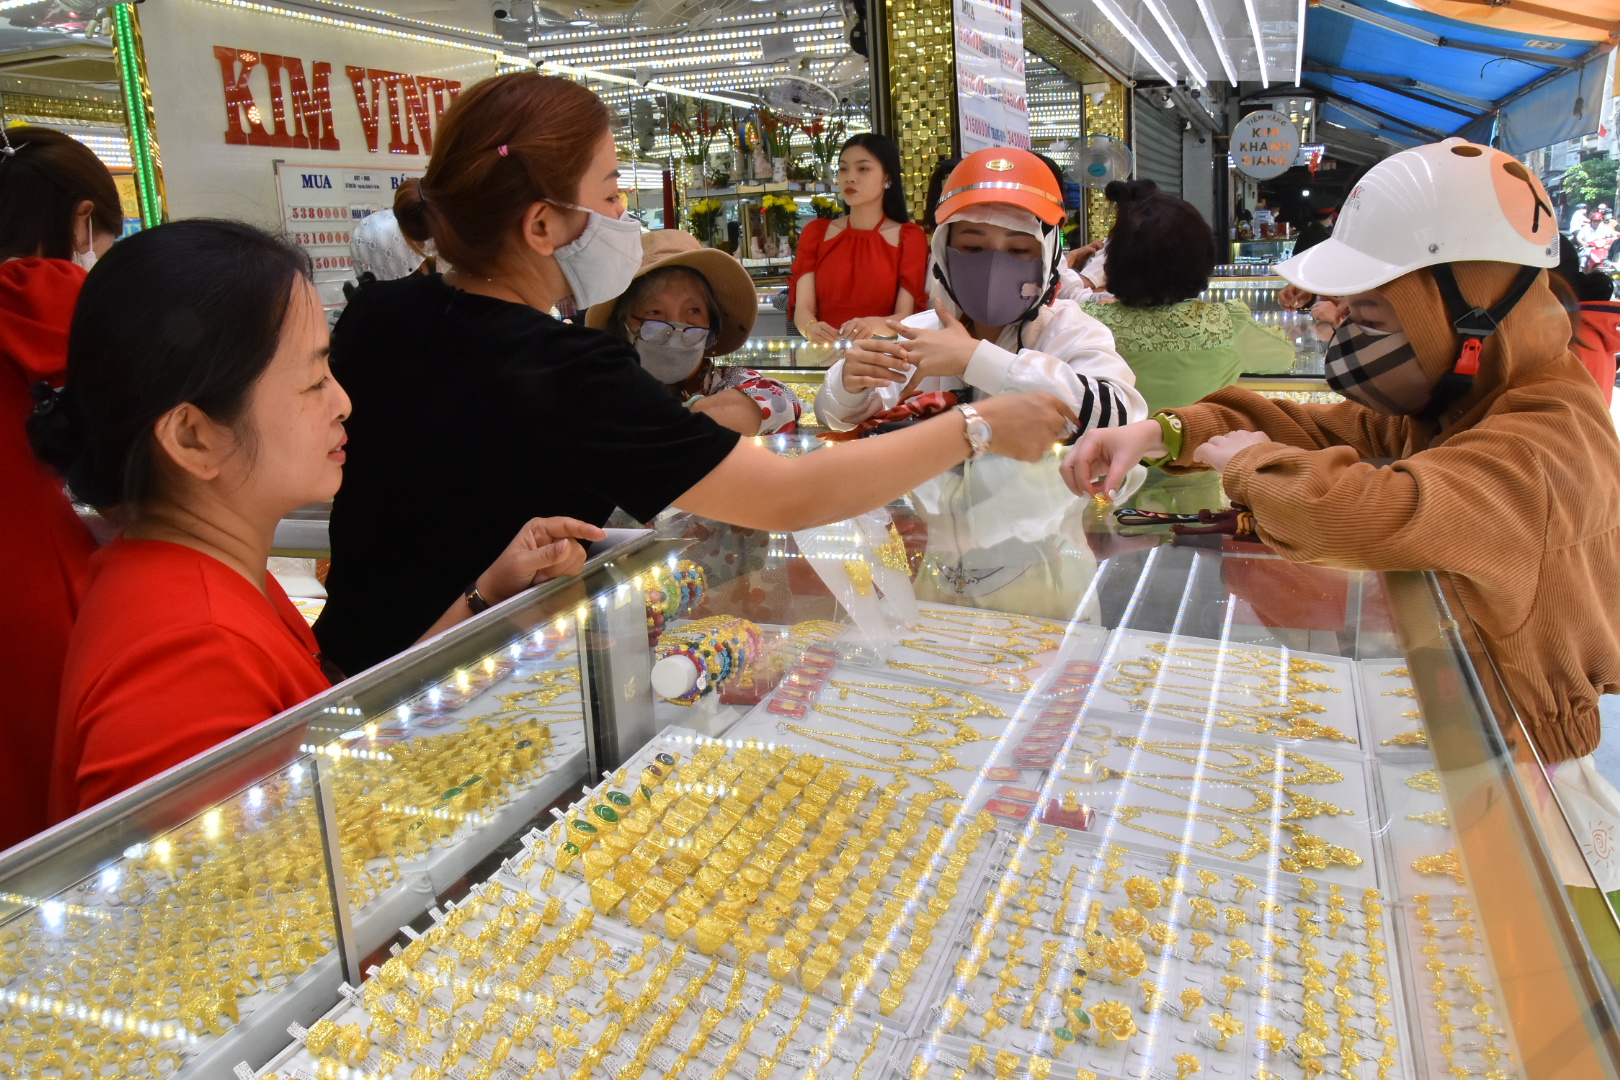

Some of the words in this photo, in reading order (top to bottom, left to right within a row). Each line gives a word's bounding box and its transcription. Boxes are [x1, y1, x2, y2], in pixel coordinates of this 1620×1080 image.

[213, 46, 340, 151] KIM
[1252, 127, 1279, 138] KIM
[1241, 155, 1288, 166] GIANG
[301, 174, 332, 189] MUA
[391, 173, 410, 190] BÁ
[292, 207, 347, 219] 5380000
[296, 232, 350, 245] 5310000
[316, 257, 353, 269] 50000
